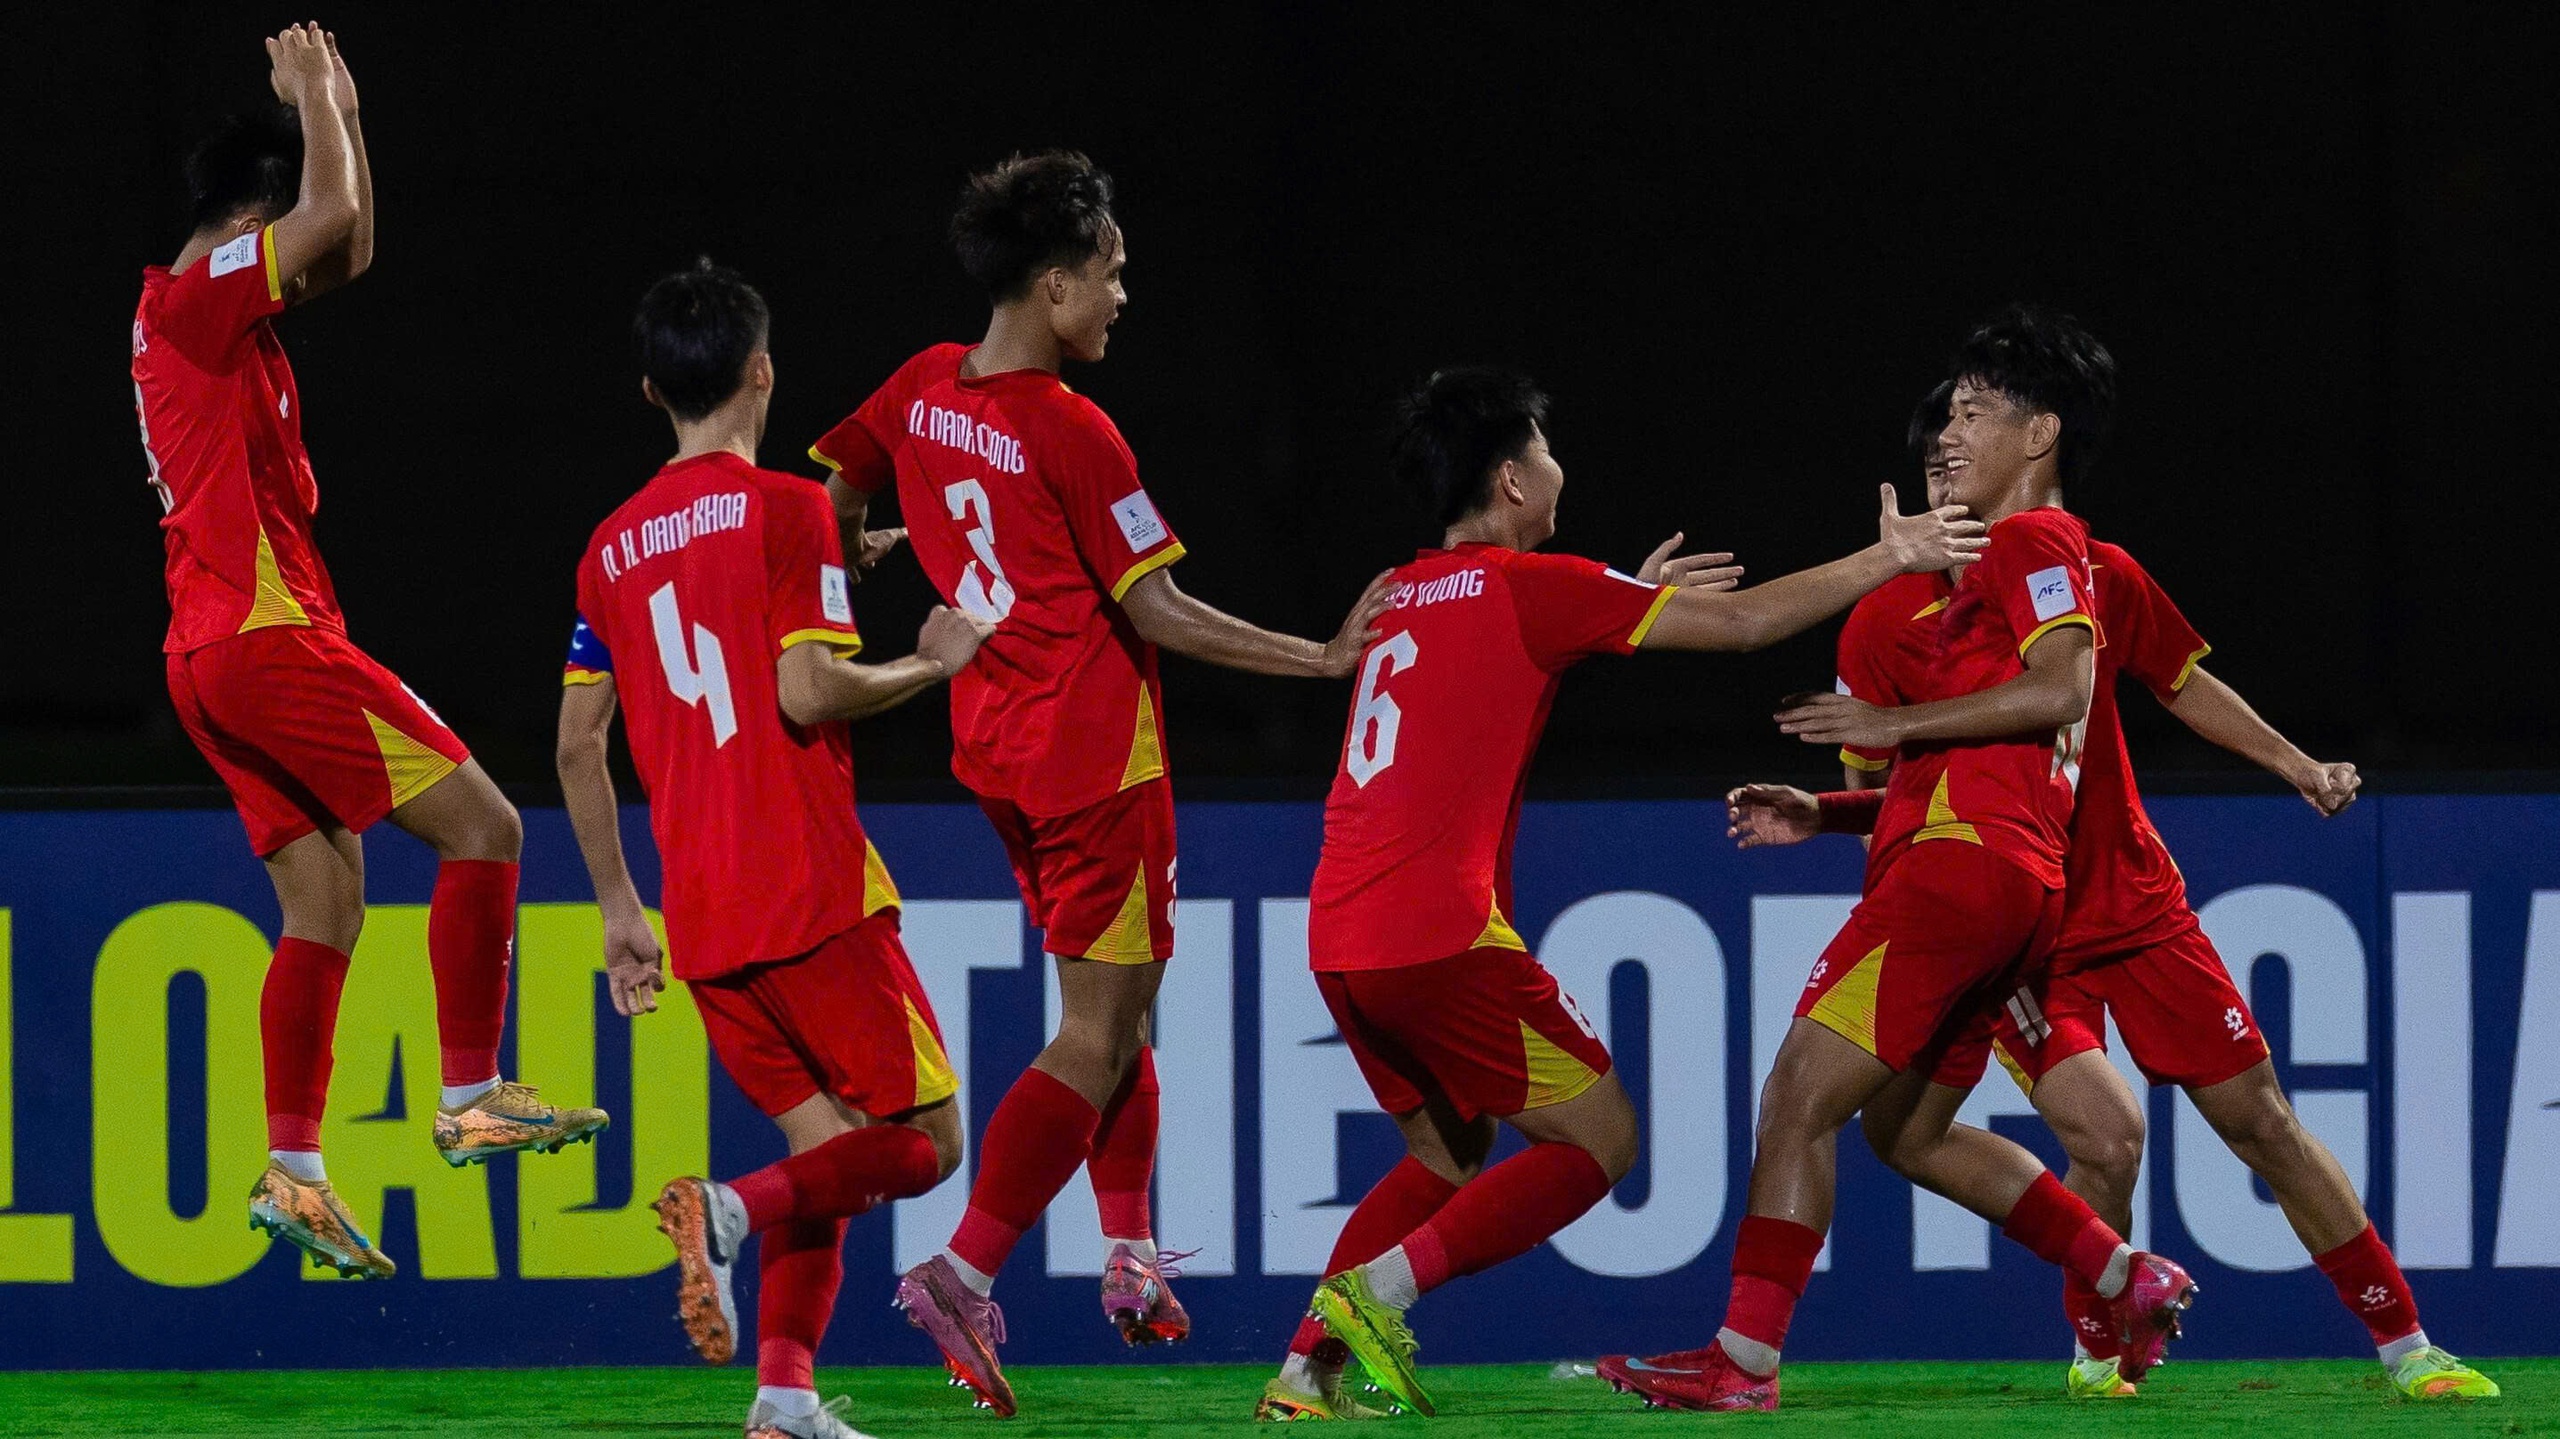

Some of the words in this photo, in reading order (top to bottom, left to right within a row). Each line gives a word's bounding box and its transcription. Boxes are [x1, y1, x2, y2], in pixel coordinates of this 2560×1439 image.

[691, 491, 748, 538] KHOA
[944, 478, 1016, 624] 3
[2036, 580, 2066, 601] AFC
[648, 580, 738, 750] 4
[1346, 629, 1419, 790] 6
[0, 900, 711, 1288] OAD
